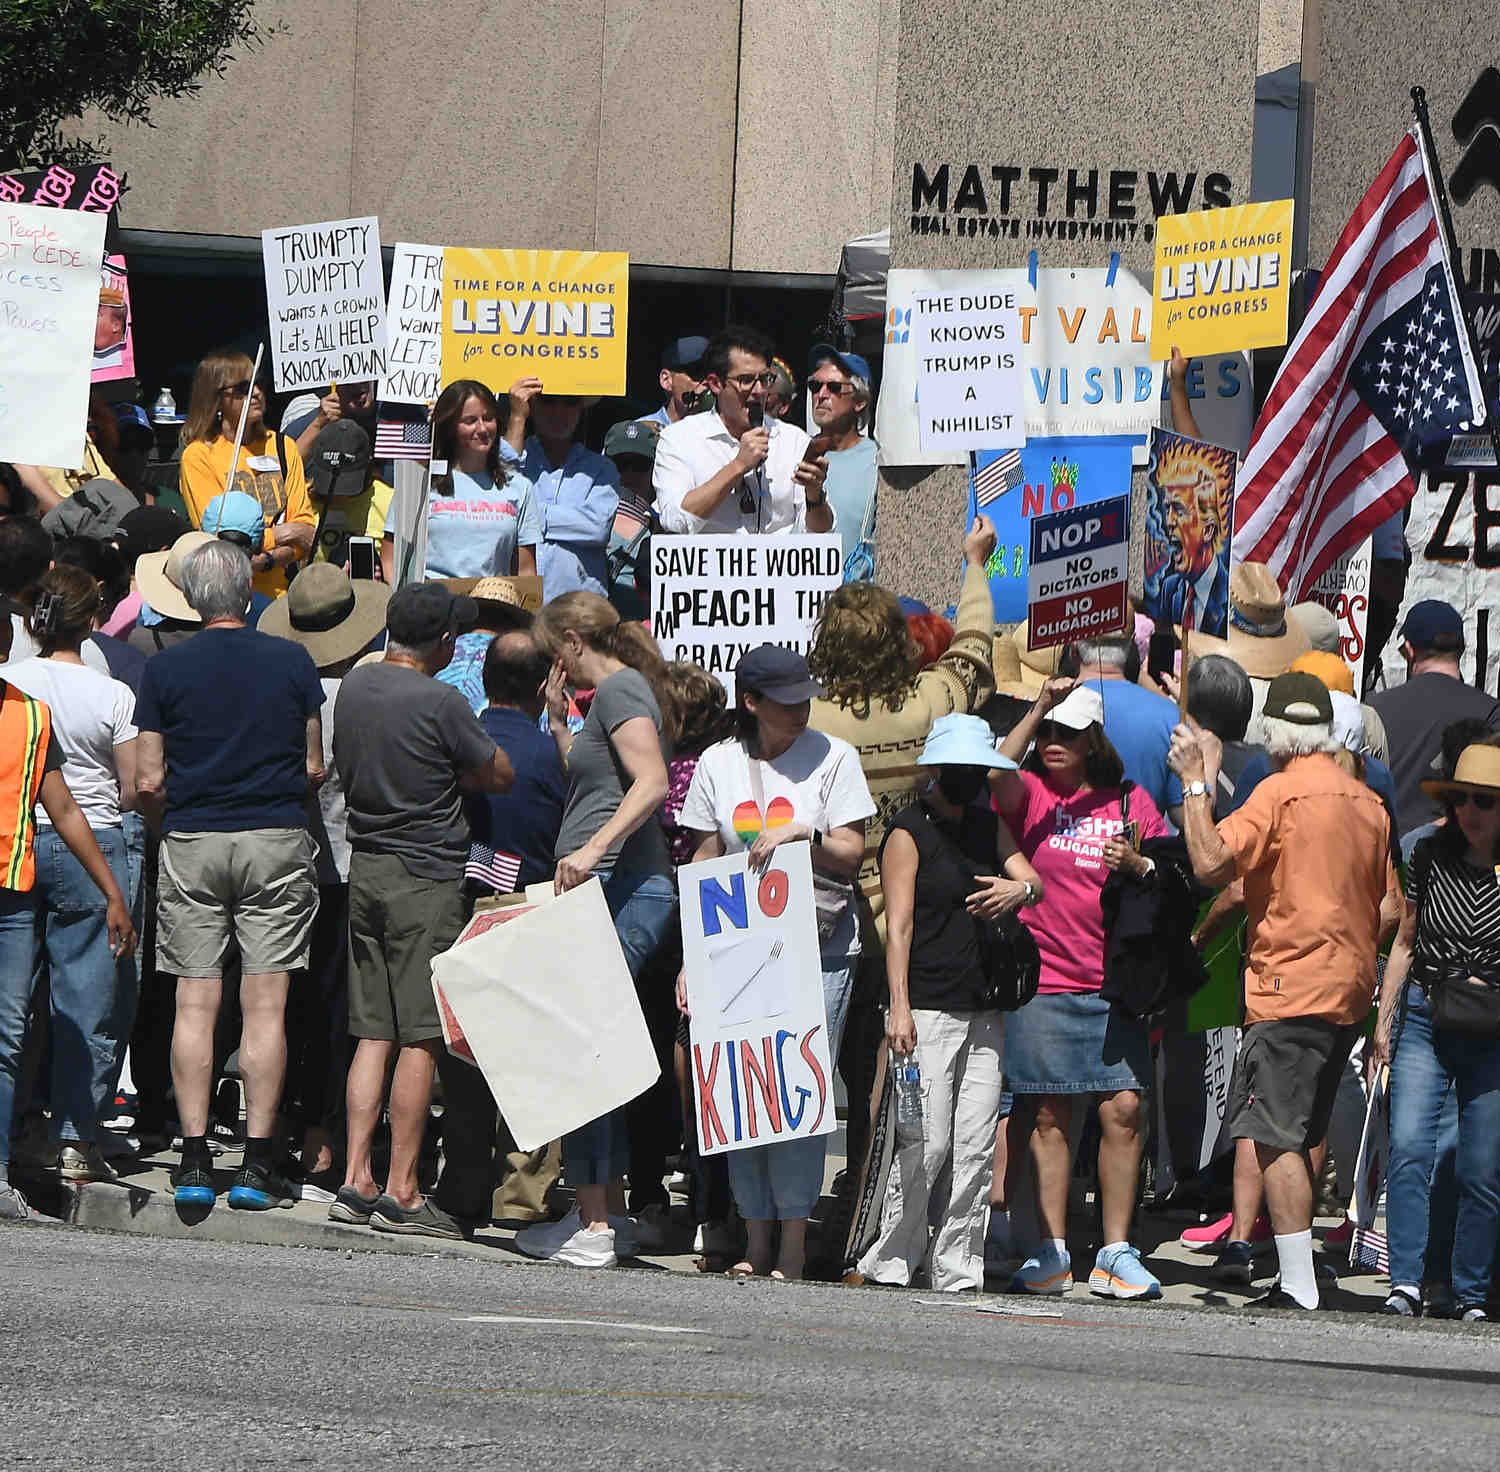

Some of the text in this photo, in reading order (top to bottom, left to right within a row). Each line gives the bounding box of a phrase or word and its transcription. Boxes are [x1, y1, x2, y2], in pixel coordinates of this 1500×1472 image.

[910, 162, 1233, 219] MATTHEWS
[275, 225, 370, 264] TRUMPTY
[910, 215, 951, 235] REAL
[957, 217, 1020, 239] ESTATE
[1026, 218, 1138, 243] INVESTMENT
[1163, 232, 1282, 258] TIME FOR A CHANGE
[285, 260, 364, 296] DUMPTY
[453, 279, 616, 294] TIME FOR A CHANGE
[1160, 251, 1281, 302] LEVINE
[321, 304, 328, 316] A
[334, 296, 378, 314] CROWN
[452, 298, 615, 337] LEVINE
[917, 294, 1016, 315] THE DUDE
[1167, 297, 1269, 328] for CONGRESS
[315, 324, 337, 352] ALL
[339, 315, 379, 347] HELP
[930, 324, 1005, 343] KNOWS
[1057, 306, 1147, 345] VAL
[282, 358, 327, 388] KNOCK
[343, 348, 387, 380] DOWN
[463, 342, 600, 363] for CONGRESS
[923, 353, 1015, 374] TRUMP IS
[964, 387, 977, 401] A
[930, 415, 1014, 433] NIHILIST
[1021, 482, 1075, 518] NO
[655, 547, 840, 577] SAVE THE WORLD
[1066, 557, 1093, 576] NO
[1039, 567, 1119, 598] DICTATORS
[1065, 596, 1093, 616] NO
[1037, 606, 1119, 638] OLIGARCHS
[699, 868, 789, 937] NO
[693, 1025, 827, 1152] KINGS
[1212, 1028, 1227, 1121] EFEND
